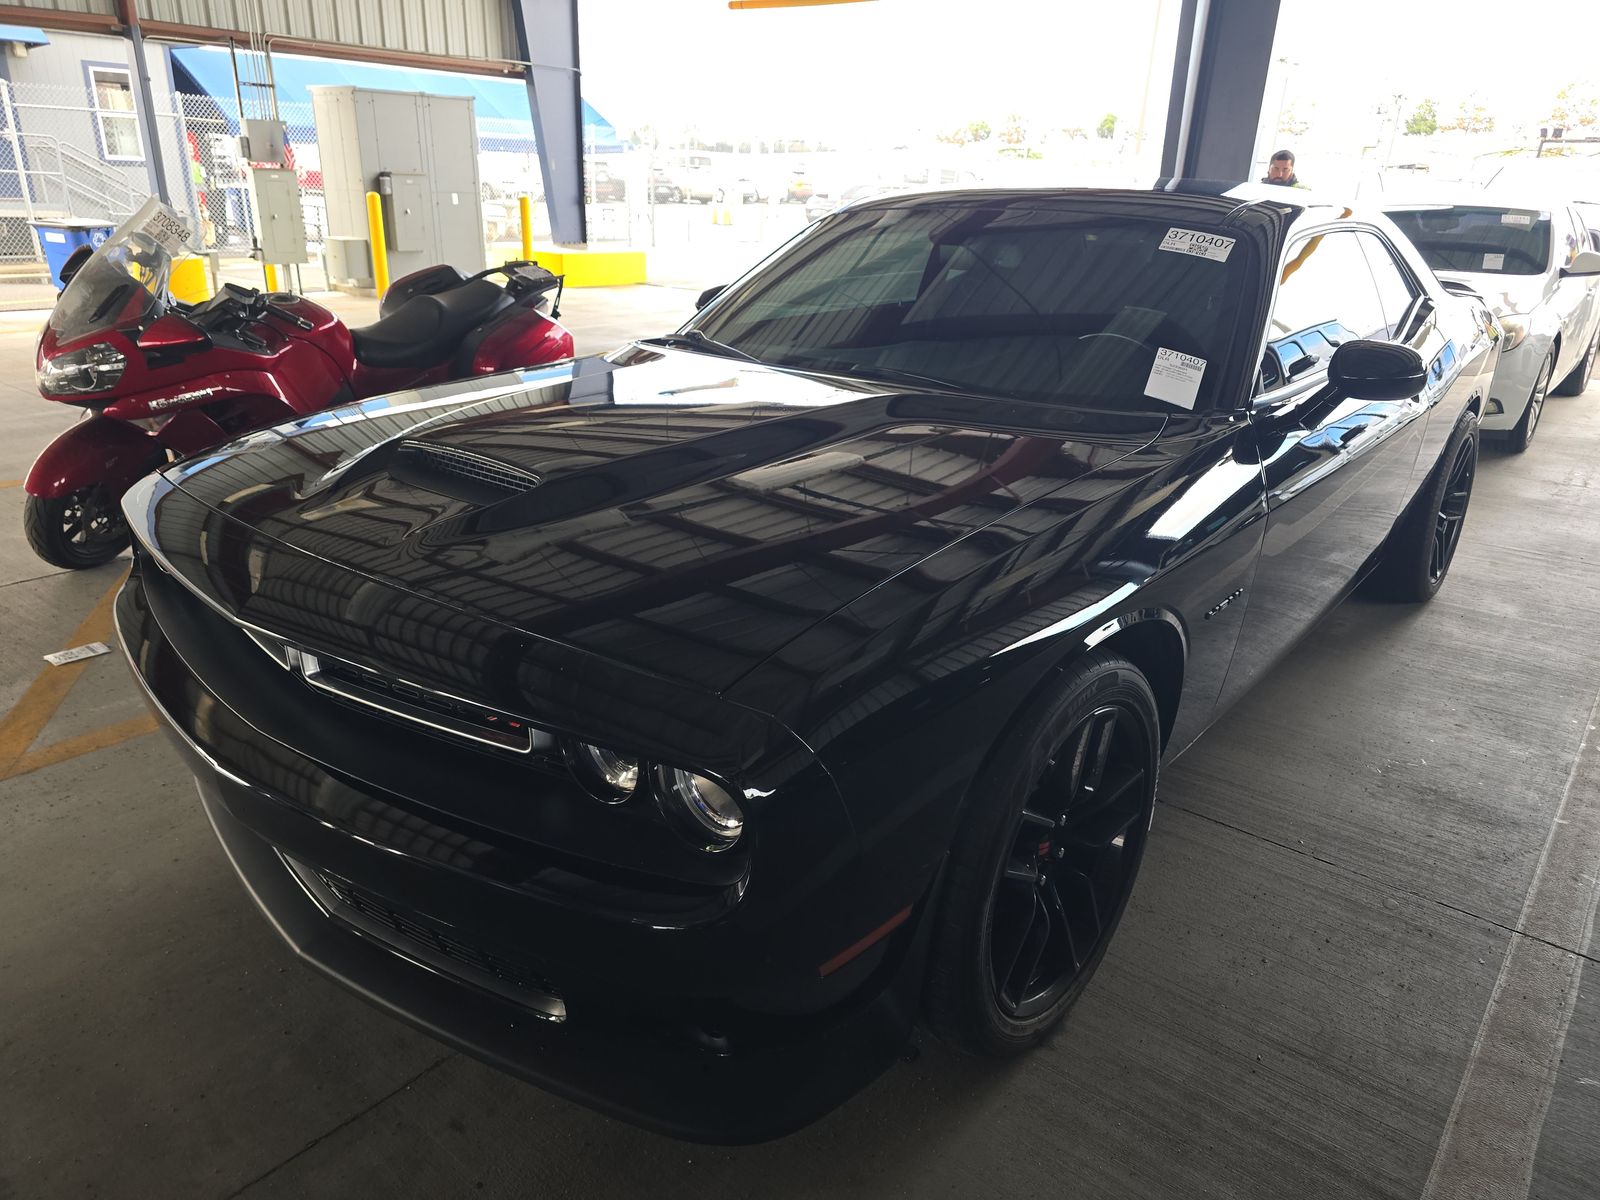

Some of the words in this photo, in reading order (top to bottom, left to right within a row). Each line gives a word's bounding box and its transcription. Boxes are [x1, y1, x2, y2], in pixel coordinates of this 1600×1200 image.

[153, 211, 191, 242] 3708348
[1168, 230, 1234, 249] 3710407
[1160, 348, 1206, 367] 3710407
